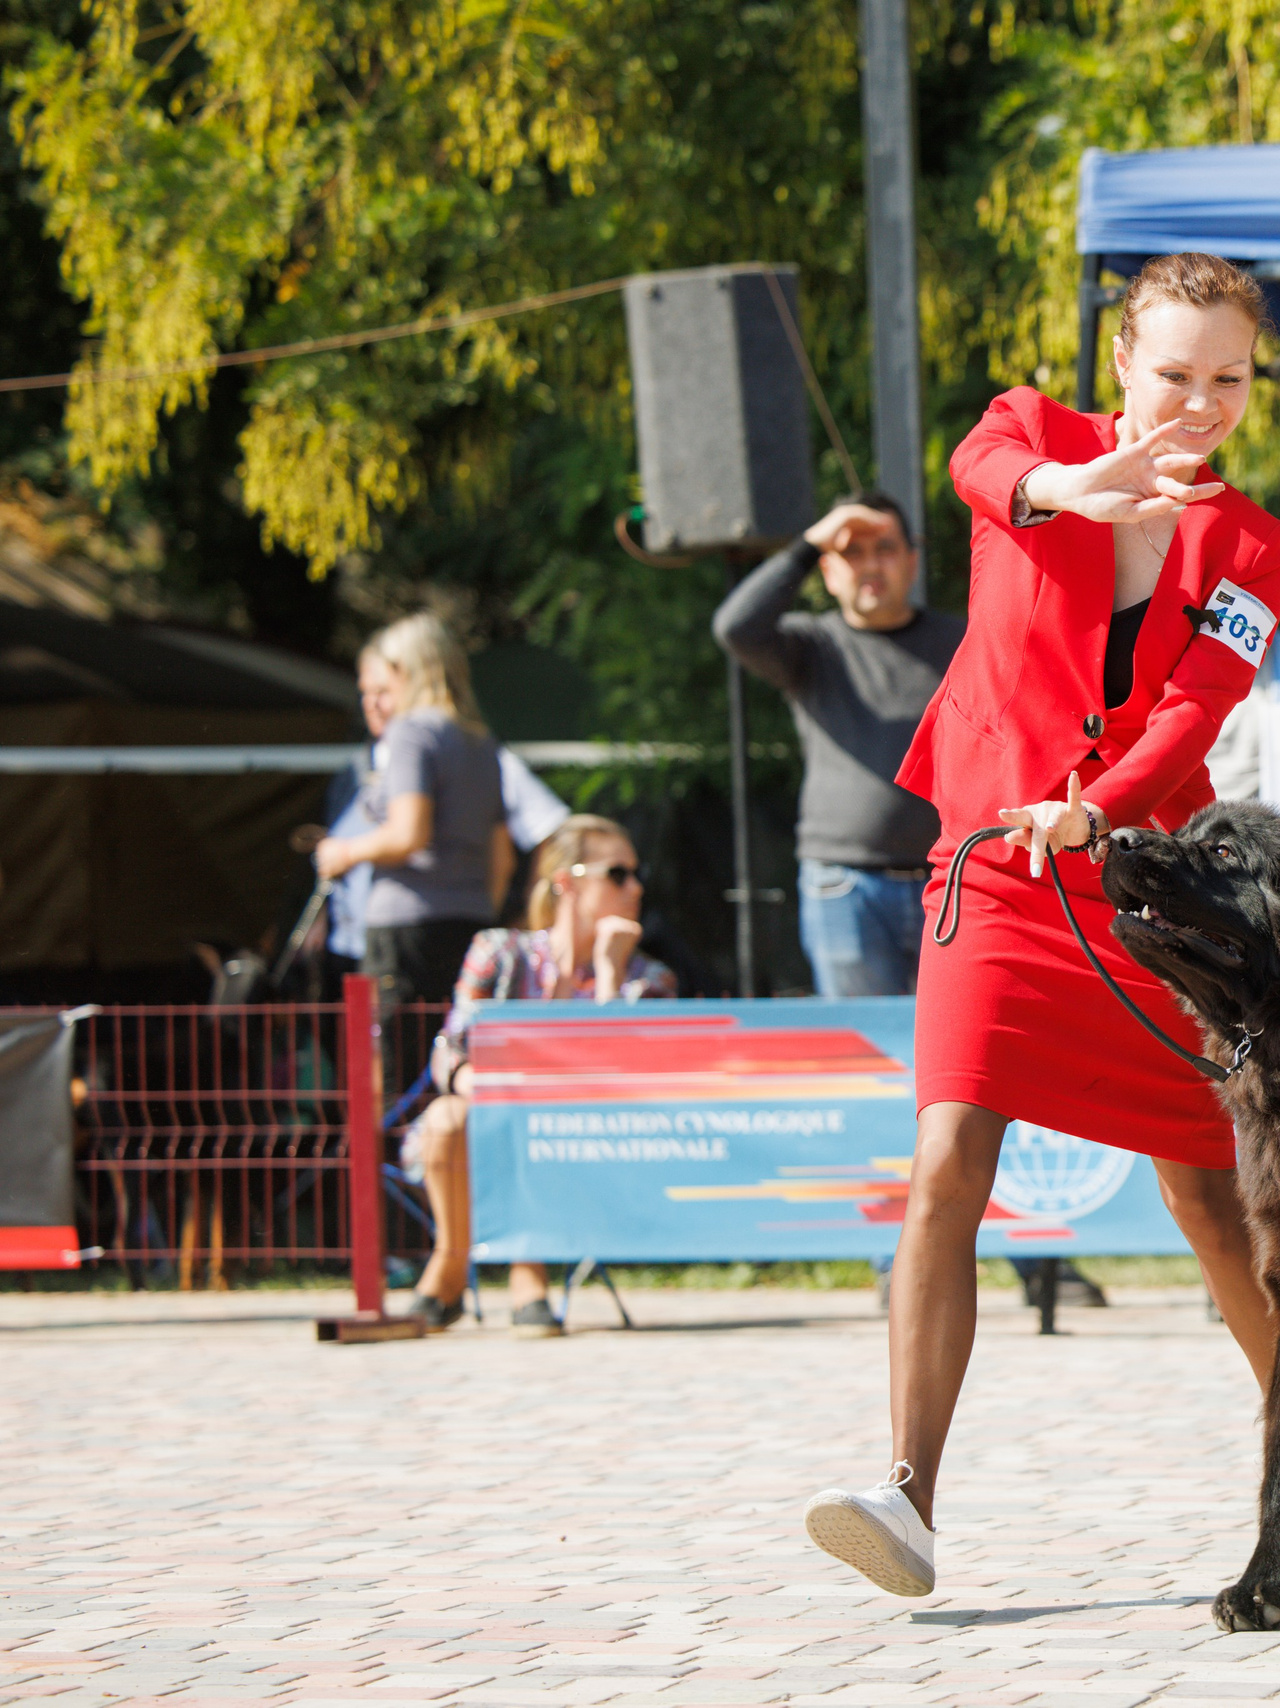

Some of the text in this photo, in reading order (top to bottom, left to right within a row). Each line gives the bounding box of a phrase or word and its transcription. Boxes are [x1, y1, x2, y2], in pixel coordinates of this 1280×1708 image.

[1215, 607, 1260, 652] 403
[528, 1109, 845, 1136] FEDERATION CYNOLOGIQUE
[528, 1138, 728, 1162] INTERNATIONALE
